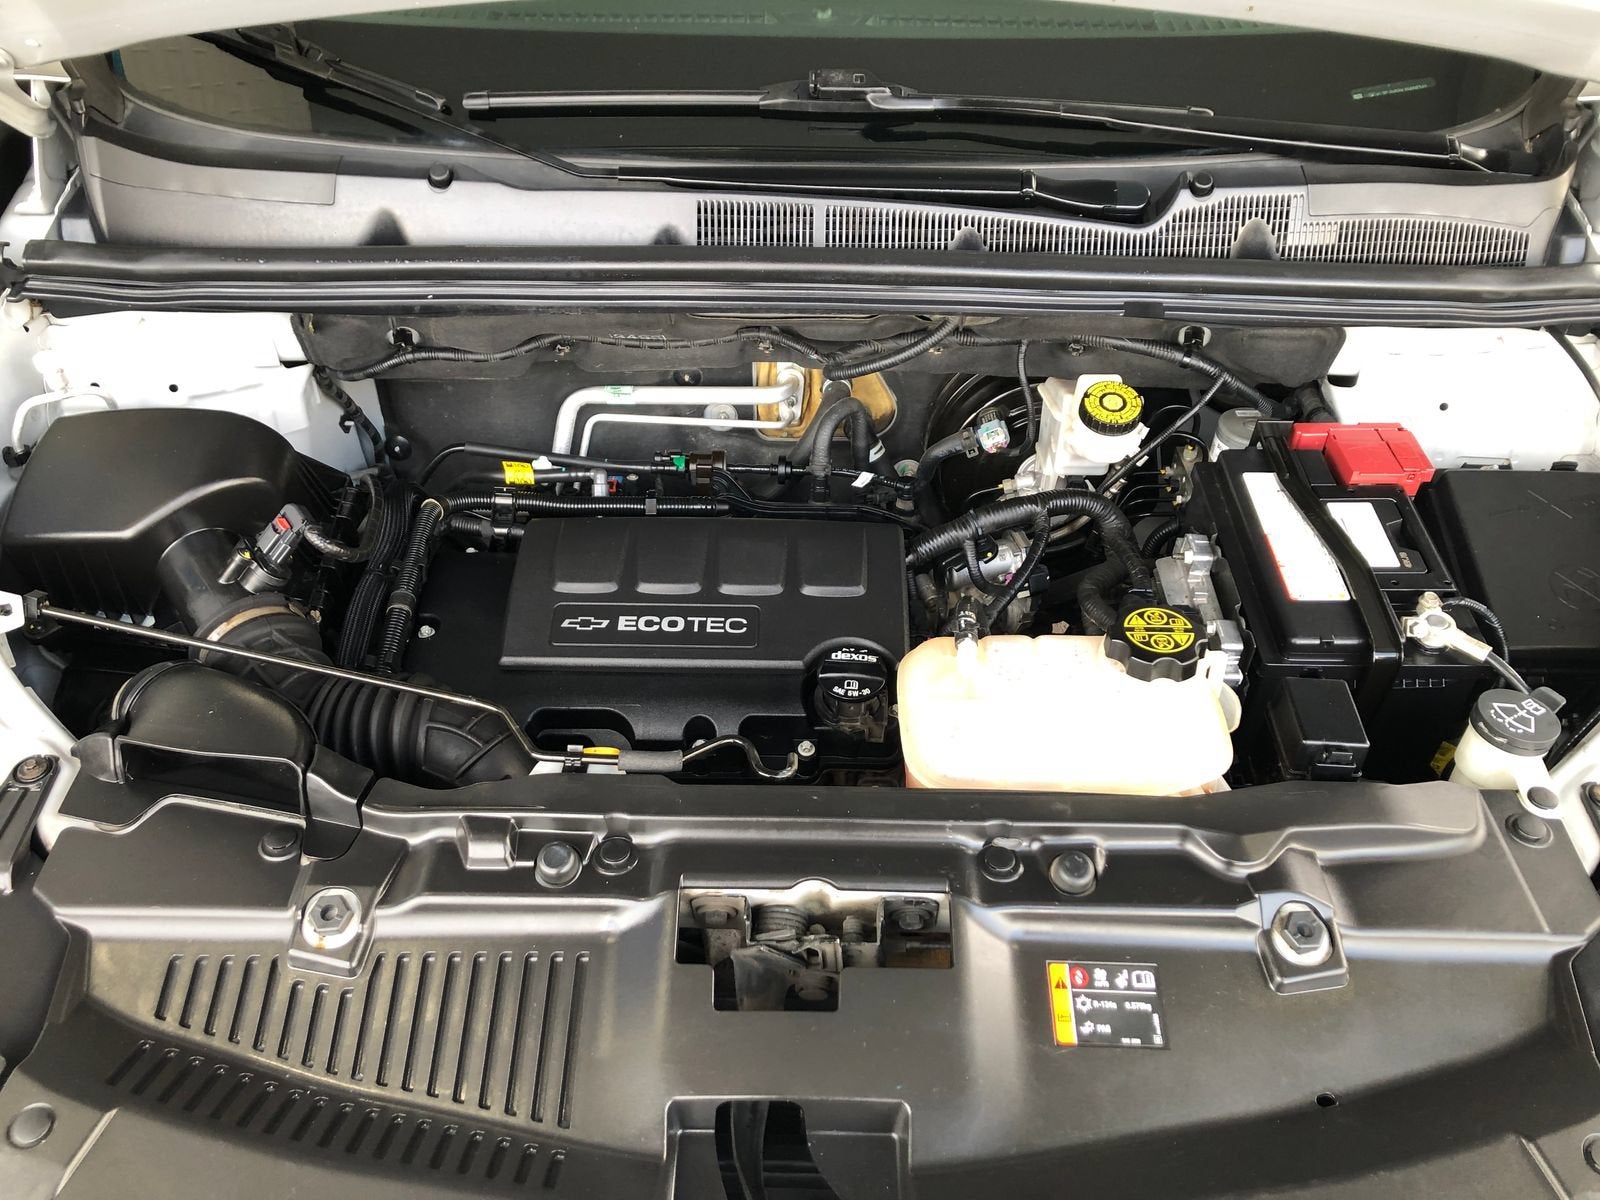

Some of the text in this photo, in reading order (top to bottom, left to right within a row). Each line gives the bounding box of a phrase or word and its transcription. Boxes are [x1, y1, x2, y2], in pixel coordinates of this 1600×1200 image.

[618, 615, 748, 634] ECOTEC
[831, 650, 879, 663] dexos
[832, 685, 871, 697] SAE 5W-30
